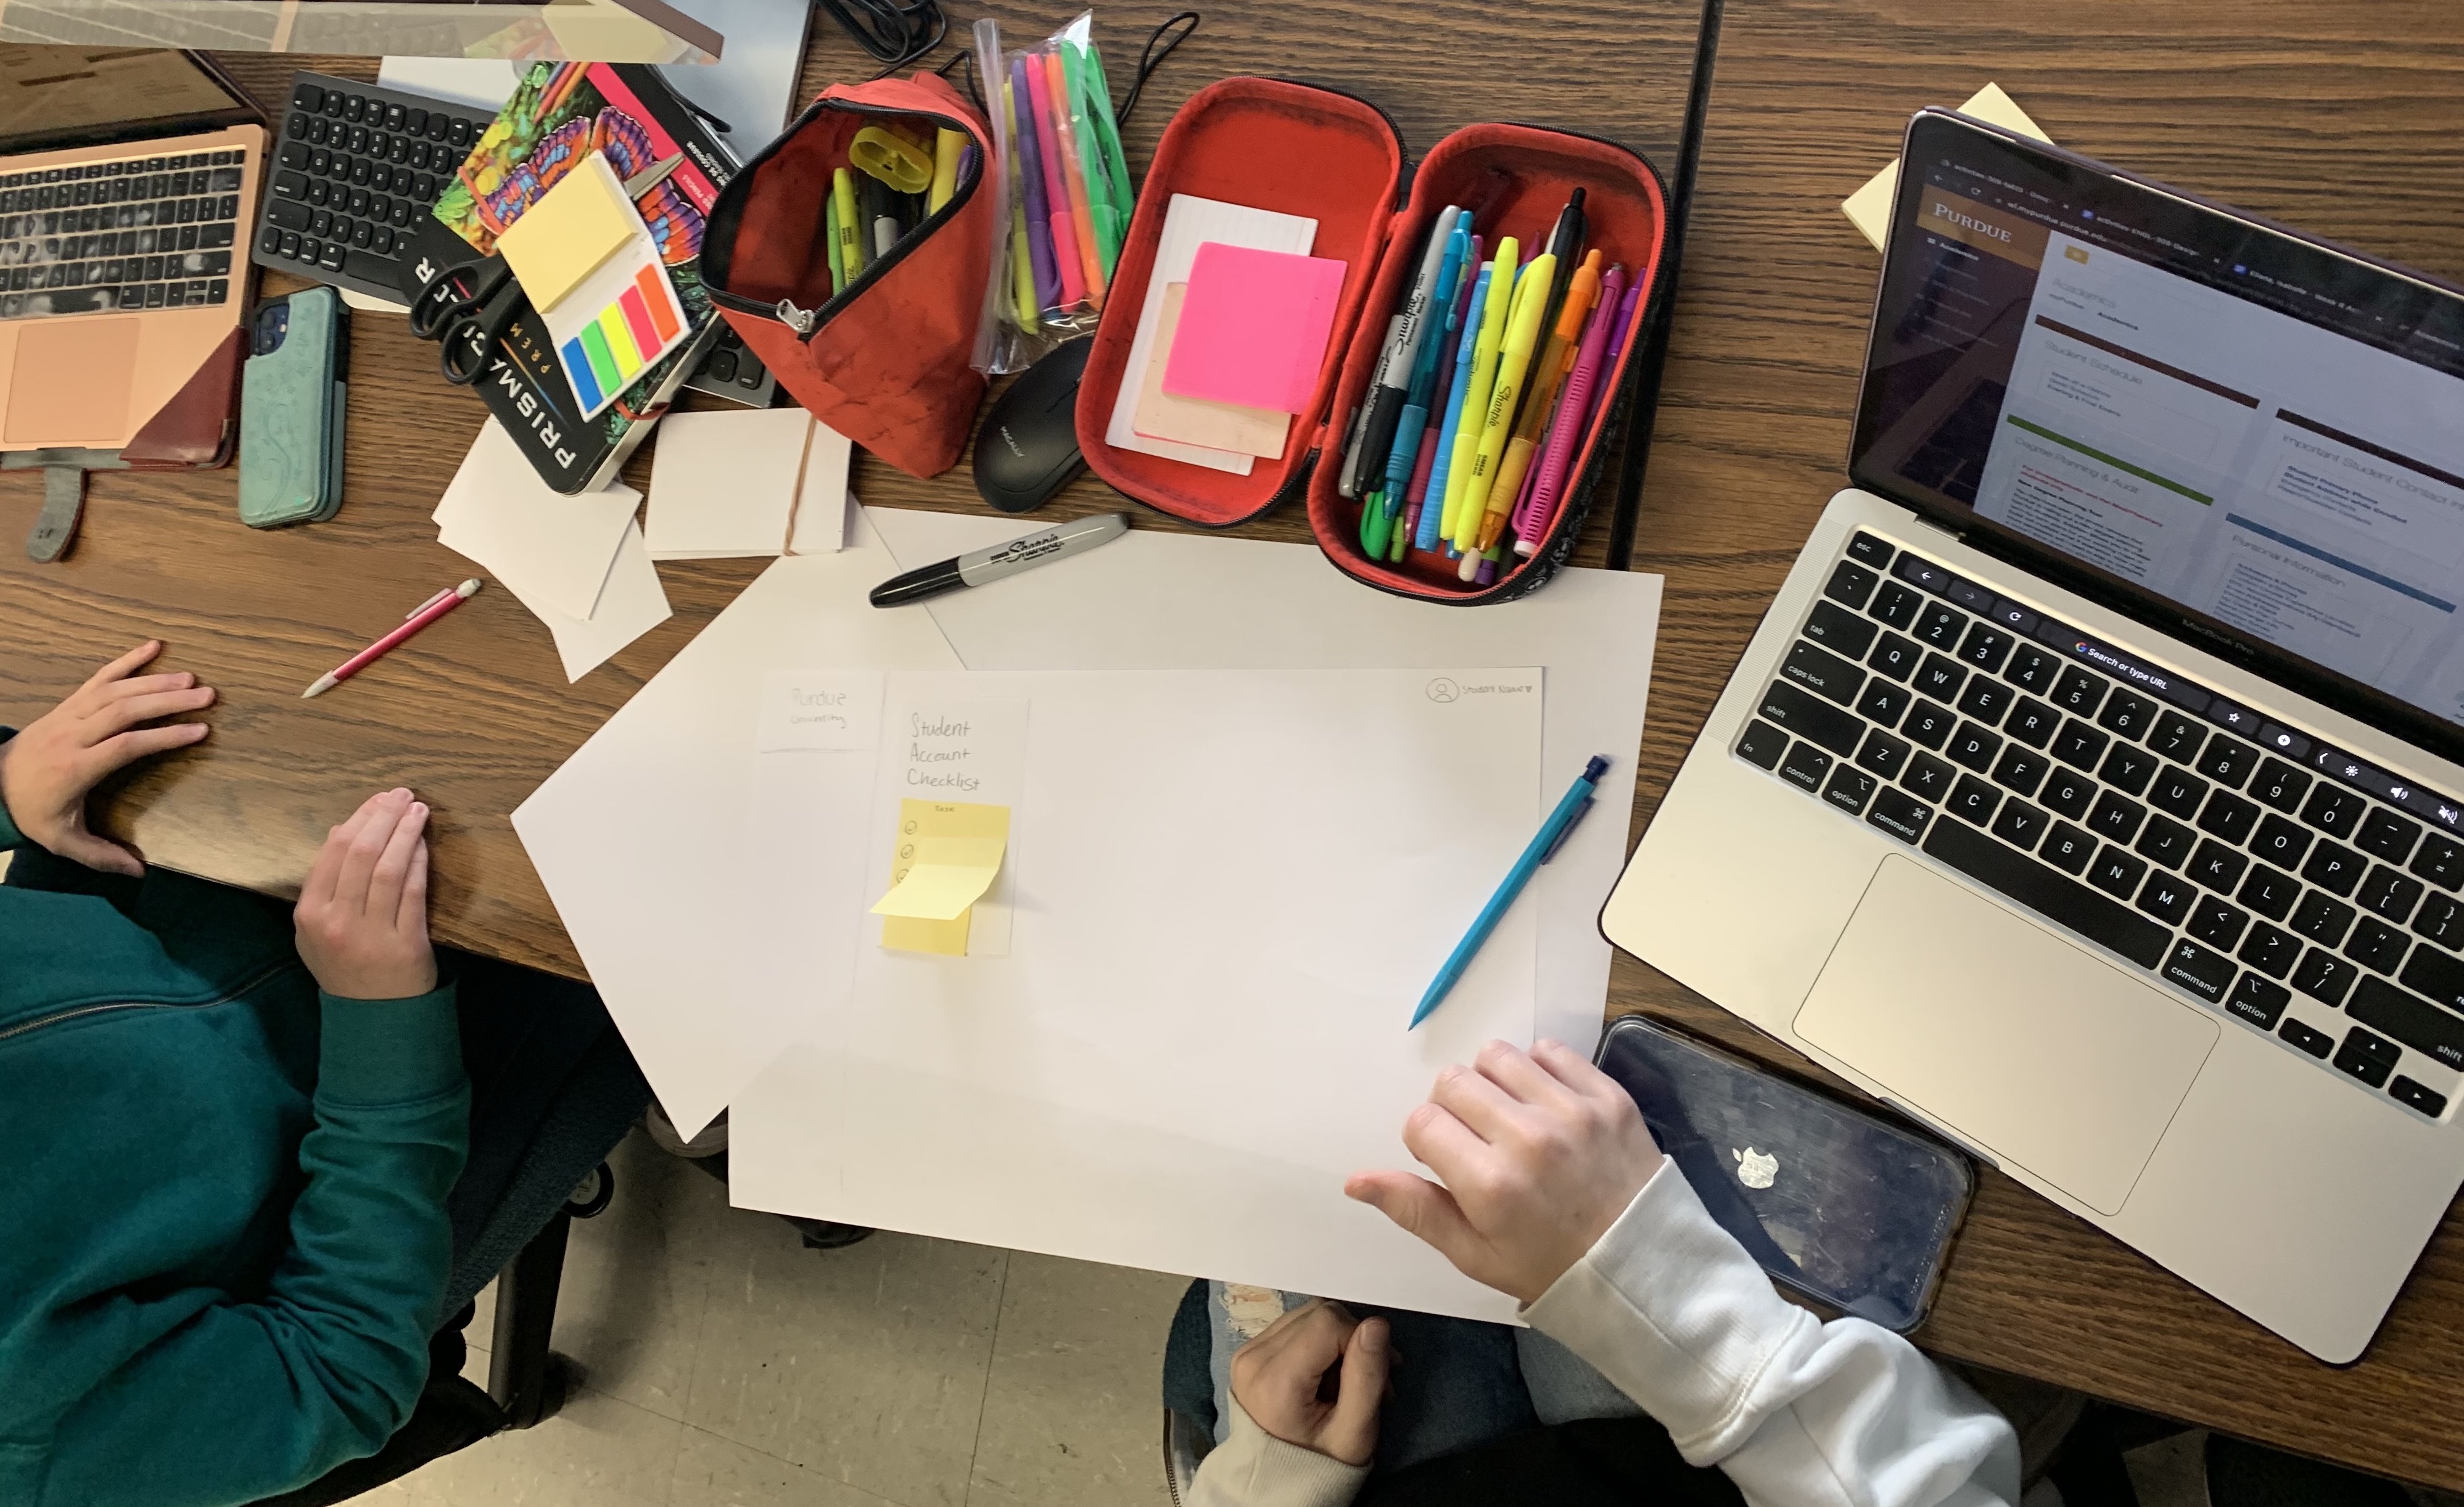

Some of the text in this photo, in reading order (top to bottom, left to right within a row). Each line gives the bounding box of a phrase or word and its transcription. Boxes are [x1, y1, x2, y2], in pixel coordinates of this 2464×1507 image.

[1934, 202, 2012, 243] PURDUE
[2045, 340, 2143, 384] Student Schedule
[2015, 436, 2053, 458] Degree
[2055, 454, 2099, 478] Planning
[2283, 435, 2340, 462] Important
[2343, 458, 2394, 482] Student
[2396, 478, 2447, 504] Contact
[1856, 543, 1871, 551] esc
[2232, 535, 2346, 587] Personal Information
[1889, 606, 1896, 616] 1
[1810, 625, 1824, 635] tab
[1931, 627, 1941, 638] 2
[2183, 618, 2254, 656] MacBook Pro
[1889, 651, 1900, 663] Q
[1977, 648, 1987, 658] 3
[2088, 648, 2118, 667] Search
[2118, 663, 2128, 671] or
[2129, 667, 2149, 682] type
[2149, 676, 2167, 690] URL
[1787, 666, 1825, 687] caps lock
[1934, 671, 1948, 683] W
[2024, 671, 2033, 680] 4
[791, 688, 847, 707] Purdue
[1877, 698, 1887, 708] A
[1980, 694, 1991, 706] E
[2071, 692, 2082, 703] 5
[1766, 705, 1786, 719] shift
[911, 712, 971, 738] Student
[1922, 719, 1934, 730] S
[2026, 717, 2037, 728] R
[2119, 715, 2129, 725] 6
[1744, 743, 1753, 752] fn
[1967, 741, 1979, 751] D
[2076, 739, 2086, 749] T
[2169, 738, 2179, 748] 7
[910, 742, 971, 763] Account
[1877, 749, 1889, 760] Z
[2015, 764, 2026, 773] F
[2125, 762, 2135, 774] Y
[2219, 762, 2230, 773] 8
[907, 768, 981, 791] Checklist
[1786, 766, 1815, 785] control
[1922, 770, 1934, 783] X
[2062, 788, 2073, 798] G
[2172, 786, 2184, 798] U
[2270, 787, 2281, 797] 9
[1832, 790, 1858, 807] option
[1968, 795, 1979, 805] C
[2016, 817, 2027, 828] V
[2110, 811, 2122, 824] H
[1874, 811, 1915, 837] command
[2062, 841, 2073, 853] B
[2161, 838, 2171, 847] J
[2275, 836, 2286, 848] O
[2110, 866, 2123, 878] N
[2210, 861, 2222, 873] K
[2328, 862, 2340, 871] P
[2159, 891, 2174, 904] M
[2263, 886, 2270, 899] L
[2170, 965, 2217, 995] command
[2235, 1000, 2267, 1021] option
[2436, 1044, 2463, 1063] shift
